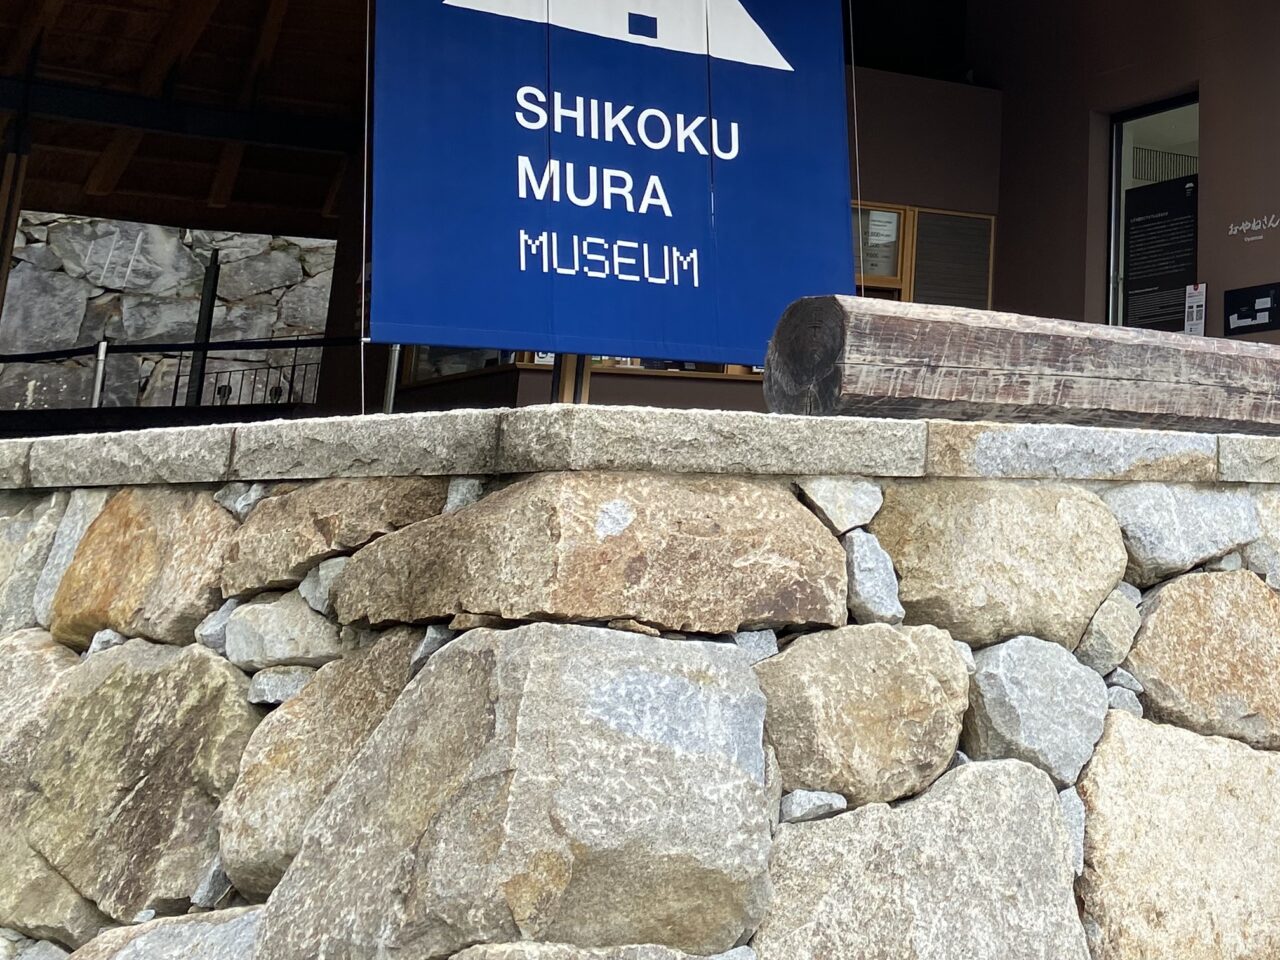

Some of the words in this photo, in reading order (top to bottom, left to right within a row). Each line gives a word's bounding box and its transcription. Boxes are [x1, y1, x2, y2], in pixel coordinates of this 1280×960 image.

[515, 85, 740, 160] SHIKOKU
[517, 155, 673, 217] MURA
[1228, 214, 1280, 235] おやねさん
[519, 230, 699, 288] MUSEUM
